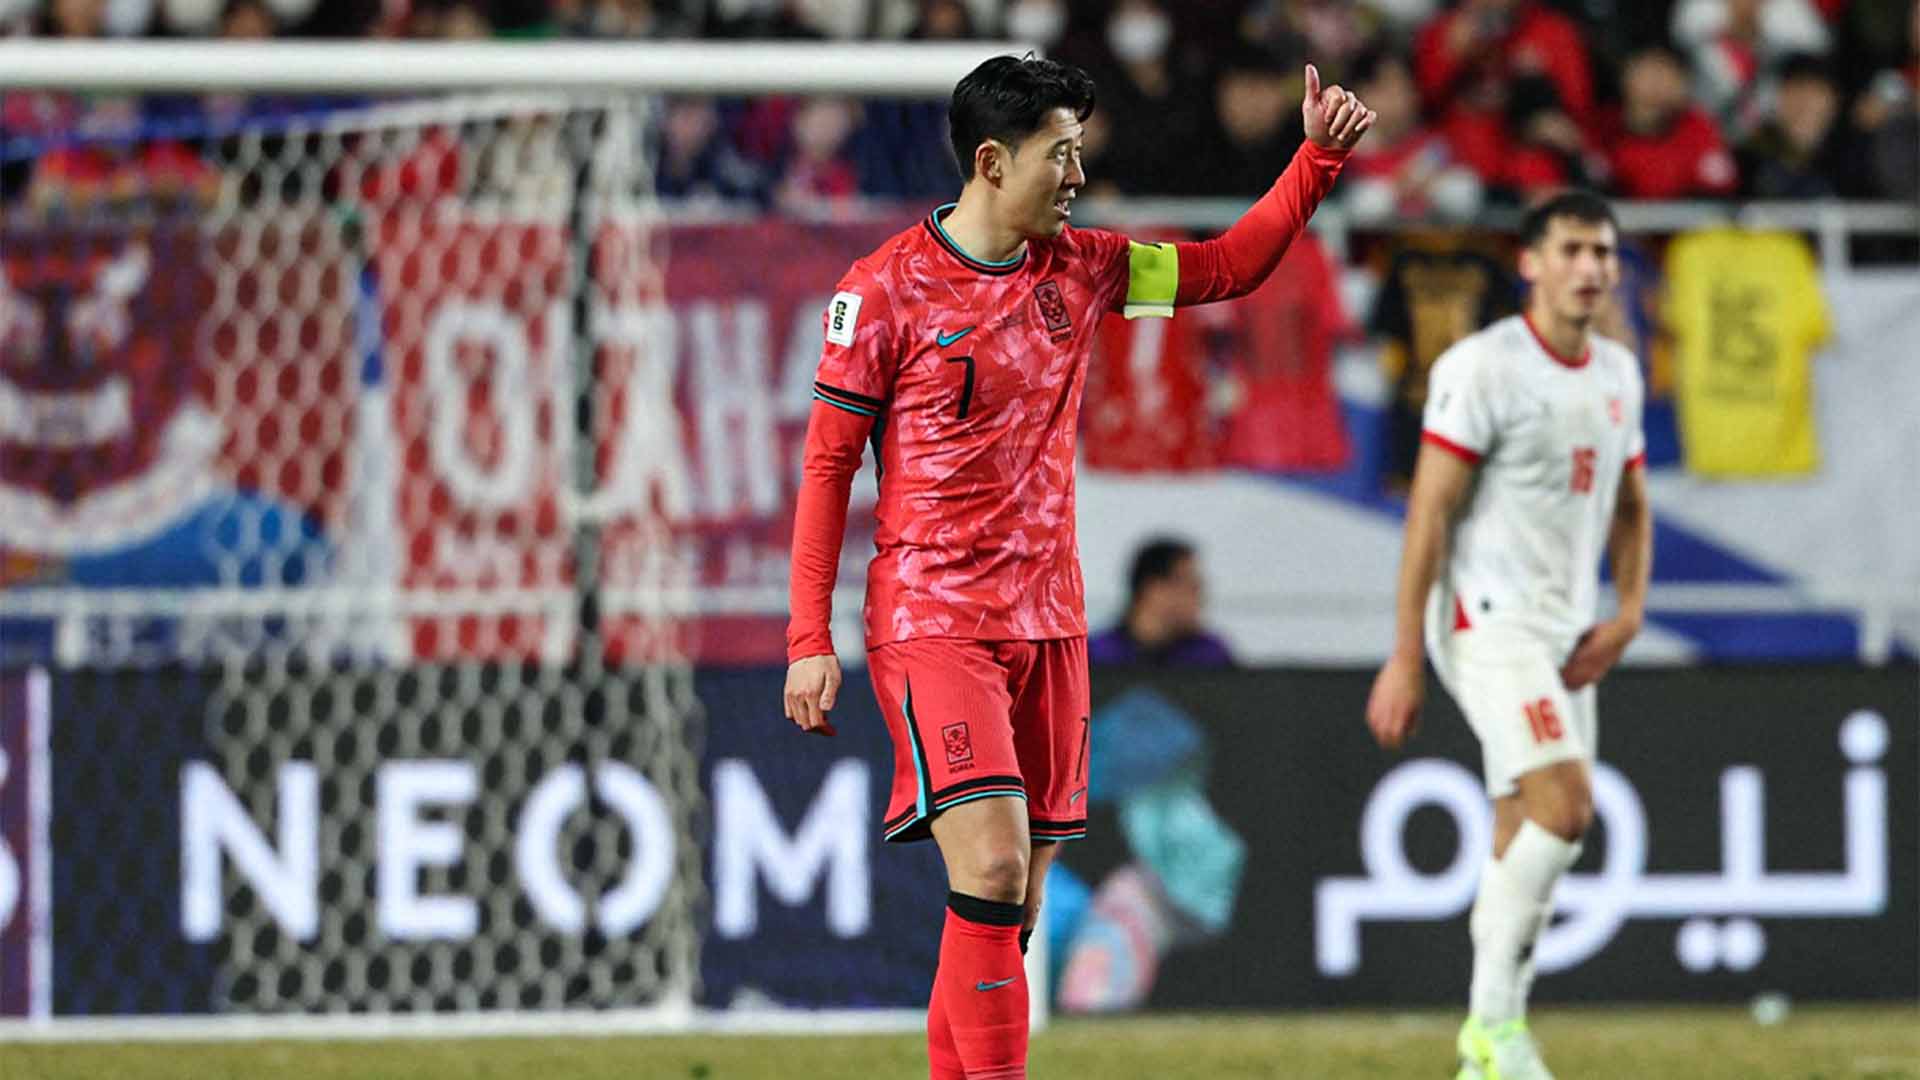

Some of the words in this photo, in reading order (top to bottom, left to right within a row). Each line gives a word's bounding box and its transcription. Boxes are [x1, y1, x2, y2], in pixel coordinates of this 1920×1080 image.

[946, 356, 976, 420] 7
[1571, 447, 1596, 494] 16
[1523, 698, 1563, 743] 16
[180, 758, 872, 942] NEOM
